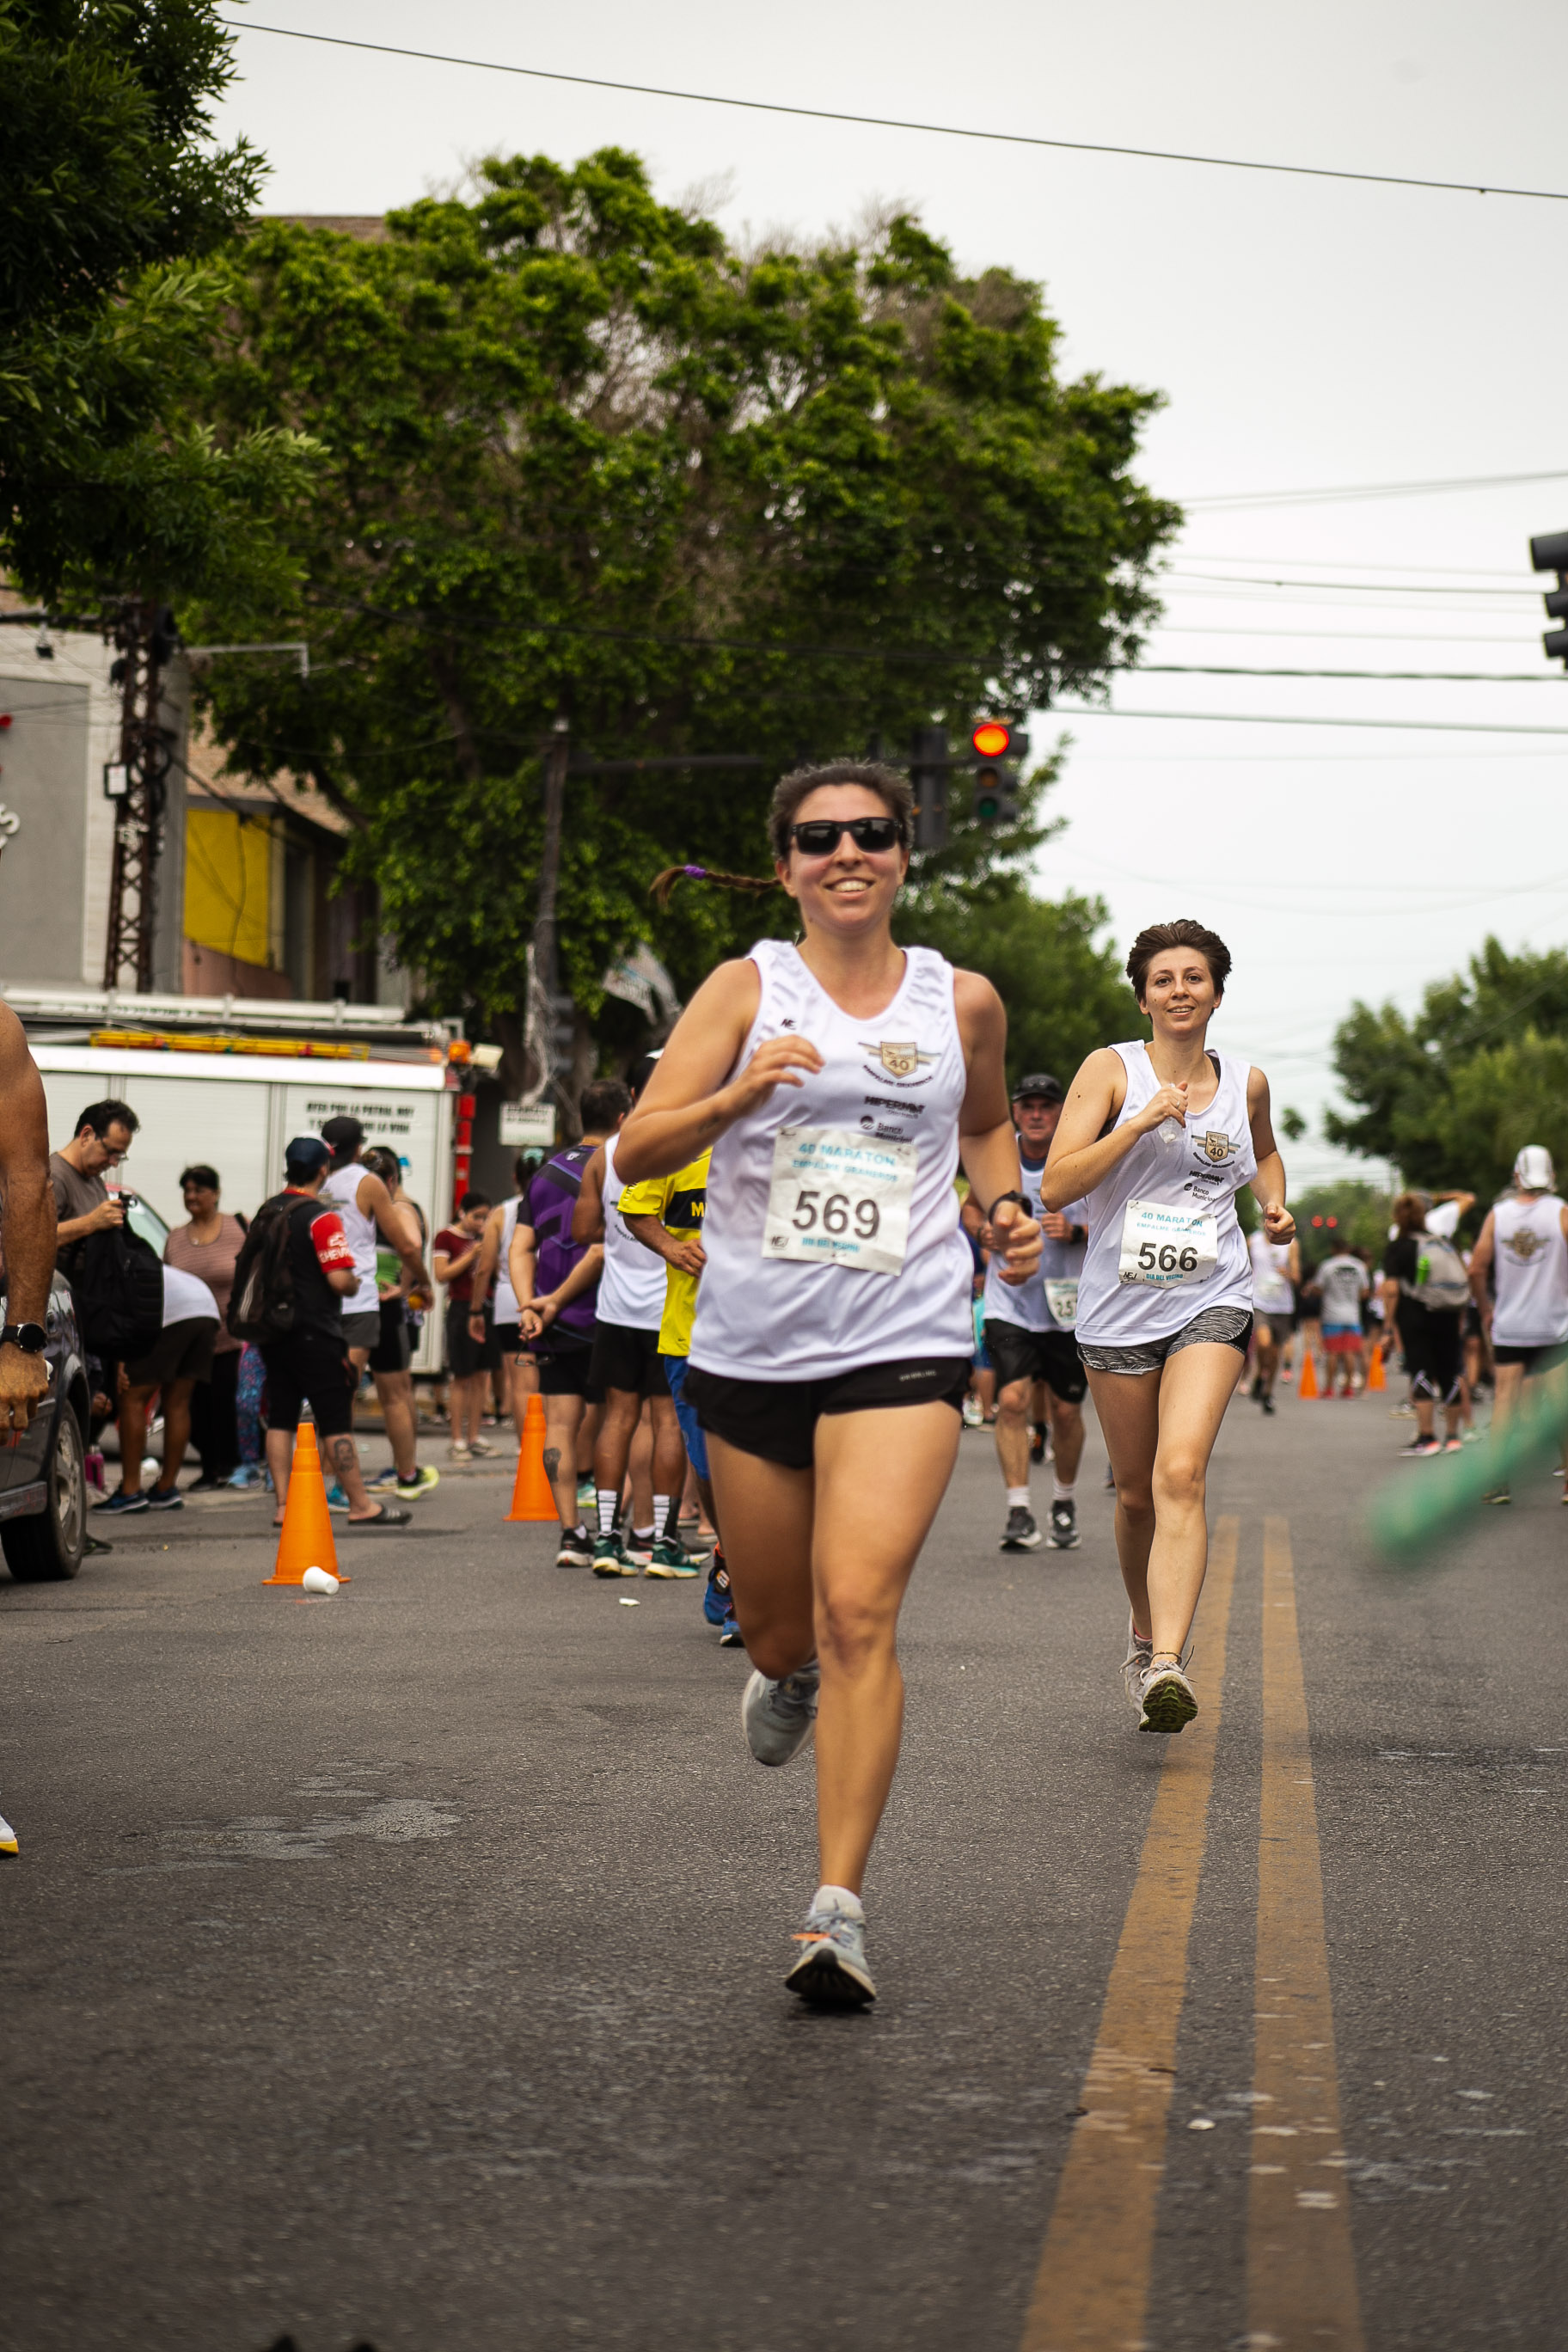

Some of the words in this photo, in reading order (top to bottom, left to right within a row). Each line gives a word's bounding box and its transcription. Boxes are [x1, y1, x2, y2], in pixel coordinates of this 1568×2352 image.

[890, 1060, 910, 1070] 40
[877, 1123, 903, 1134] Banco
[799, 1143, 816, 1154] 40
[821, 1145, 895, 1166] MARATON
[1210, 1147, 1224, 1157] 40
[1193, 1185, 1210, 1196] Banco
[1191, 1192, 1218, 1203] Municipa
[792, 1191, 880, 1240] 569
[1156, 1213, 1203, 1228] MARATON
[1136, 1222, 1169, 1232] EMPALME
[1137, 1242, 1198, 1272] 566
[1123, 1271, 1138, 1280] NEJ
